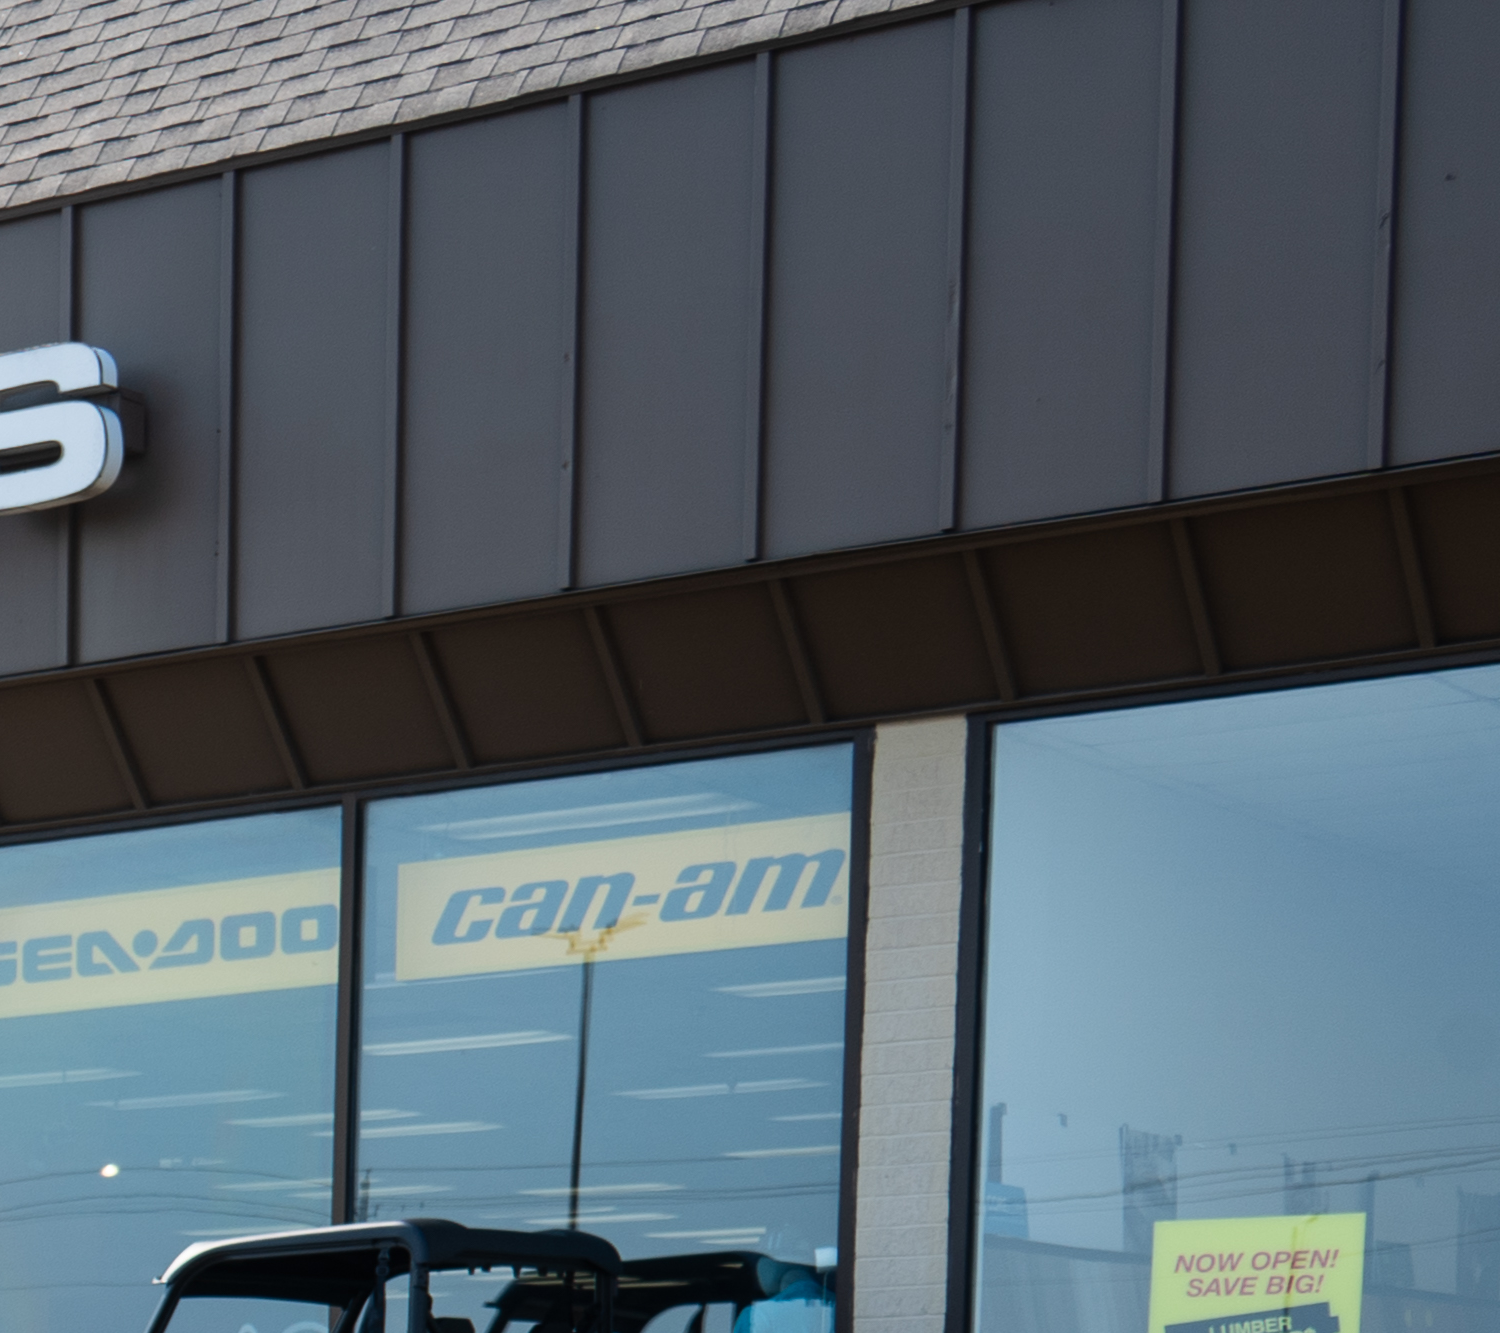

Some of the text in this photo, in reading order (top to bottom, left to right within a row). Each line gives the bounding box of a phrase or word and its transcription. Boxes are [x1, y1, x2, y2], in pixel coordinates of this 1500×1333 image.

[432, 846, 841, 947] can-am
[1174, 1249, 1339, 1274] NOW OPEN!
[1187, 1274, 1324, 1297] SAVE BIG!
